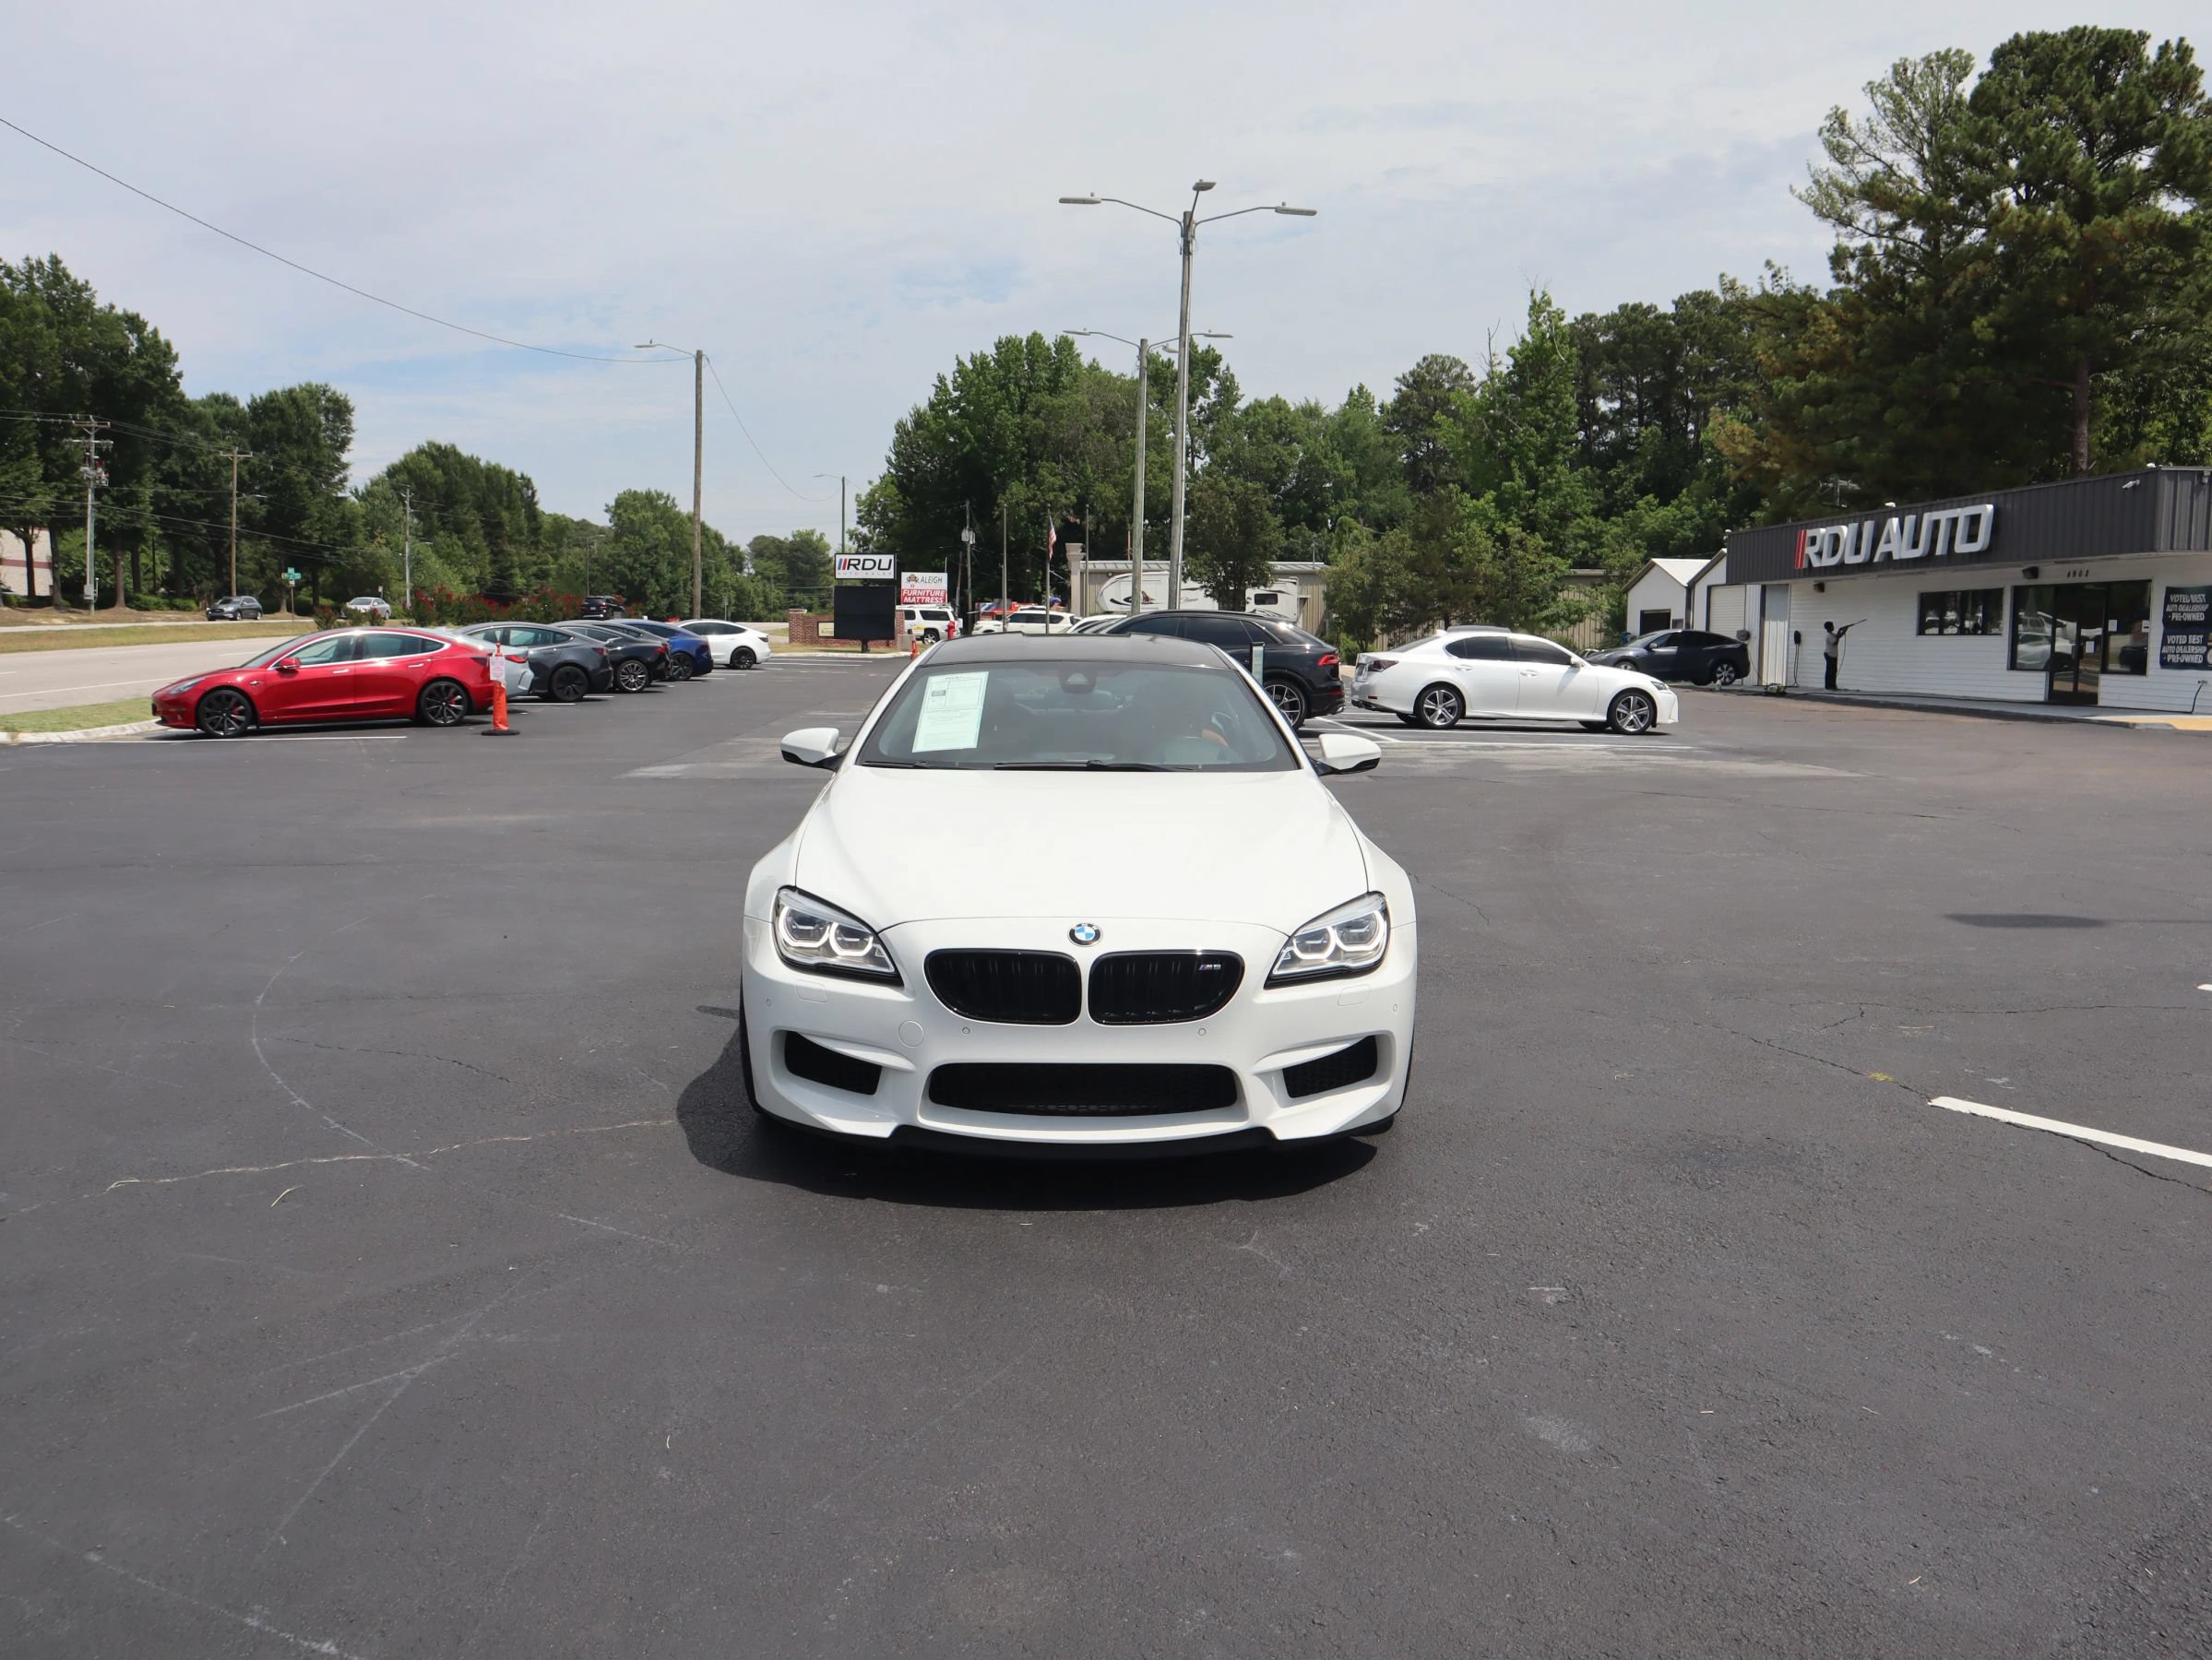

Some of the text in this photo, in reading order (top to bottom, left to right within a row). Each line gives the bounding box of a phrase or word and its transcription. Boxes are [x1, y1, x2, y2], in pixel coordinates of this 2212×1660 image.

[1803, 504, 1994, 568] RDU AUTO
[847, 558, 893, 571] RDU
[2170, 593, 2191, 603] VOTED
[2167, 634, 2204, 645] VOTED BEST
[2161, 646, 2207, 654] AUTO DEALERSHIP
